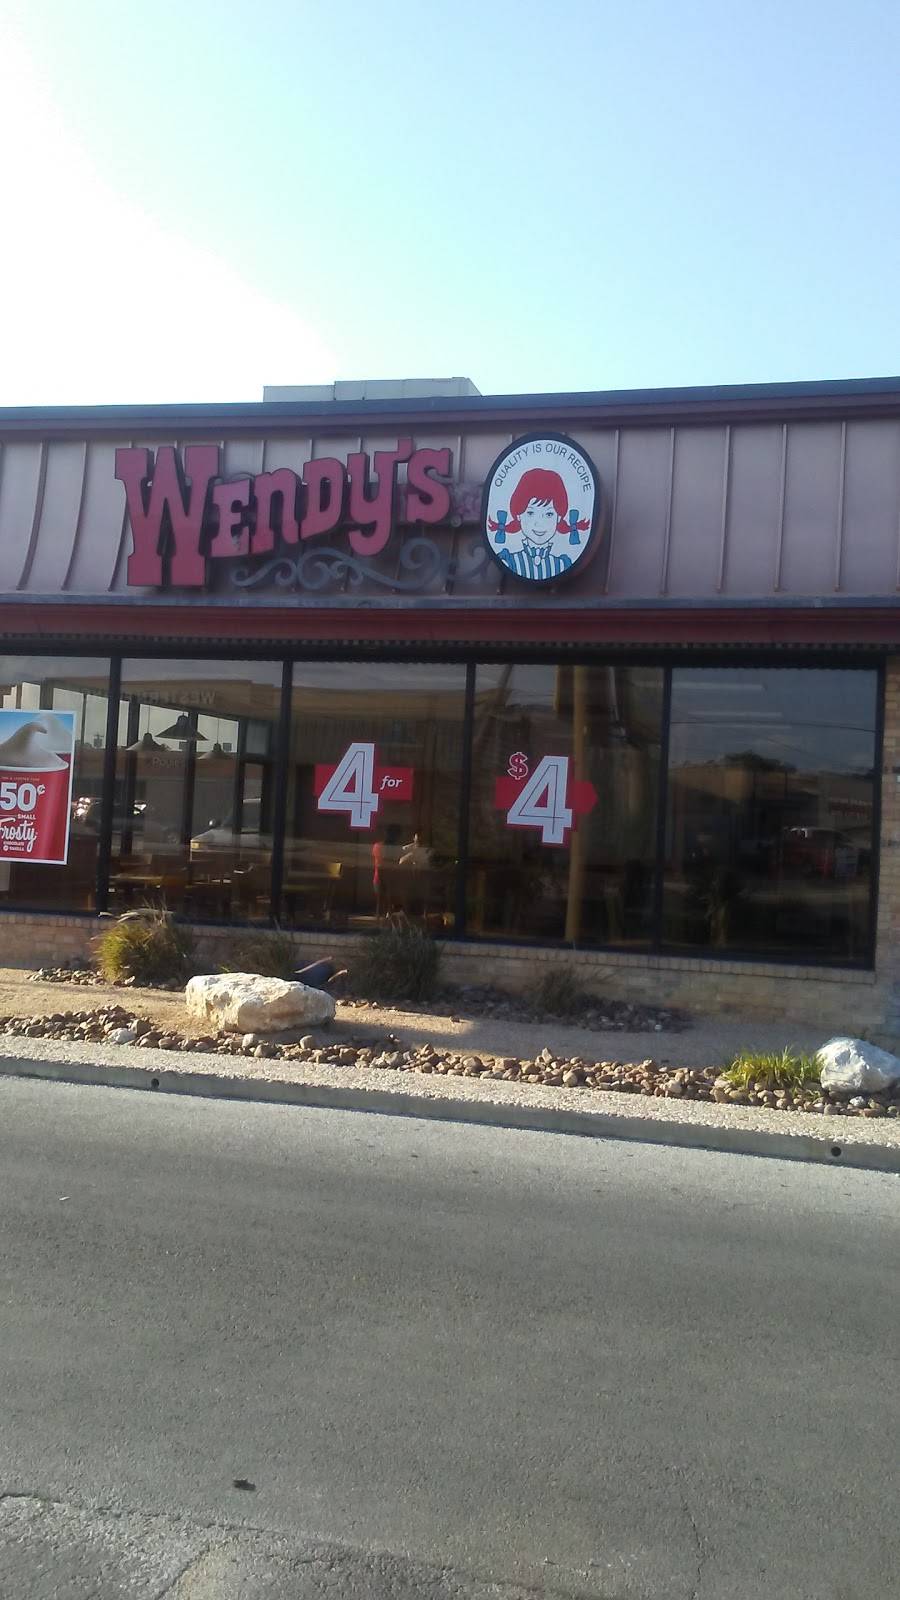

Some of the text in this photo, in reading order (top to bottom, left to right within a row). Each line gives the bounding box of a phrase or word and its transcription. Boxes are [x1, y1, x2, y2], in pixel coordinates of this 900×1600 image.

[495, 443, 592, 493] QUALITY IS OUR RECIPE
[318, 742, 403, 828] 4 for
